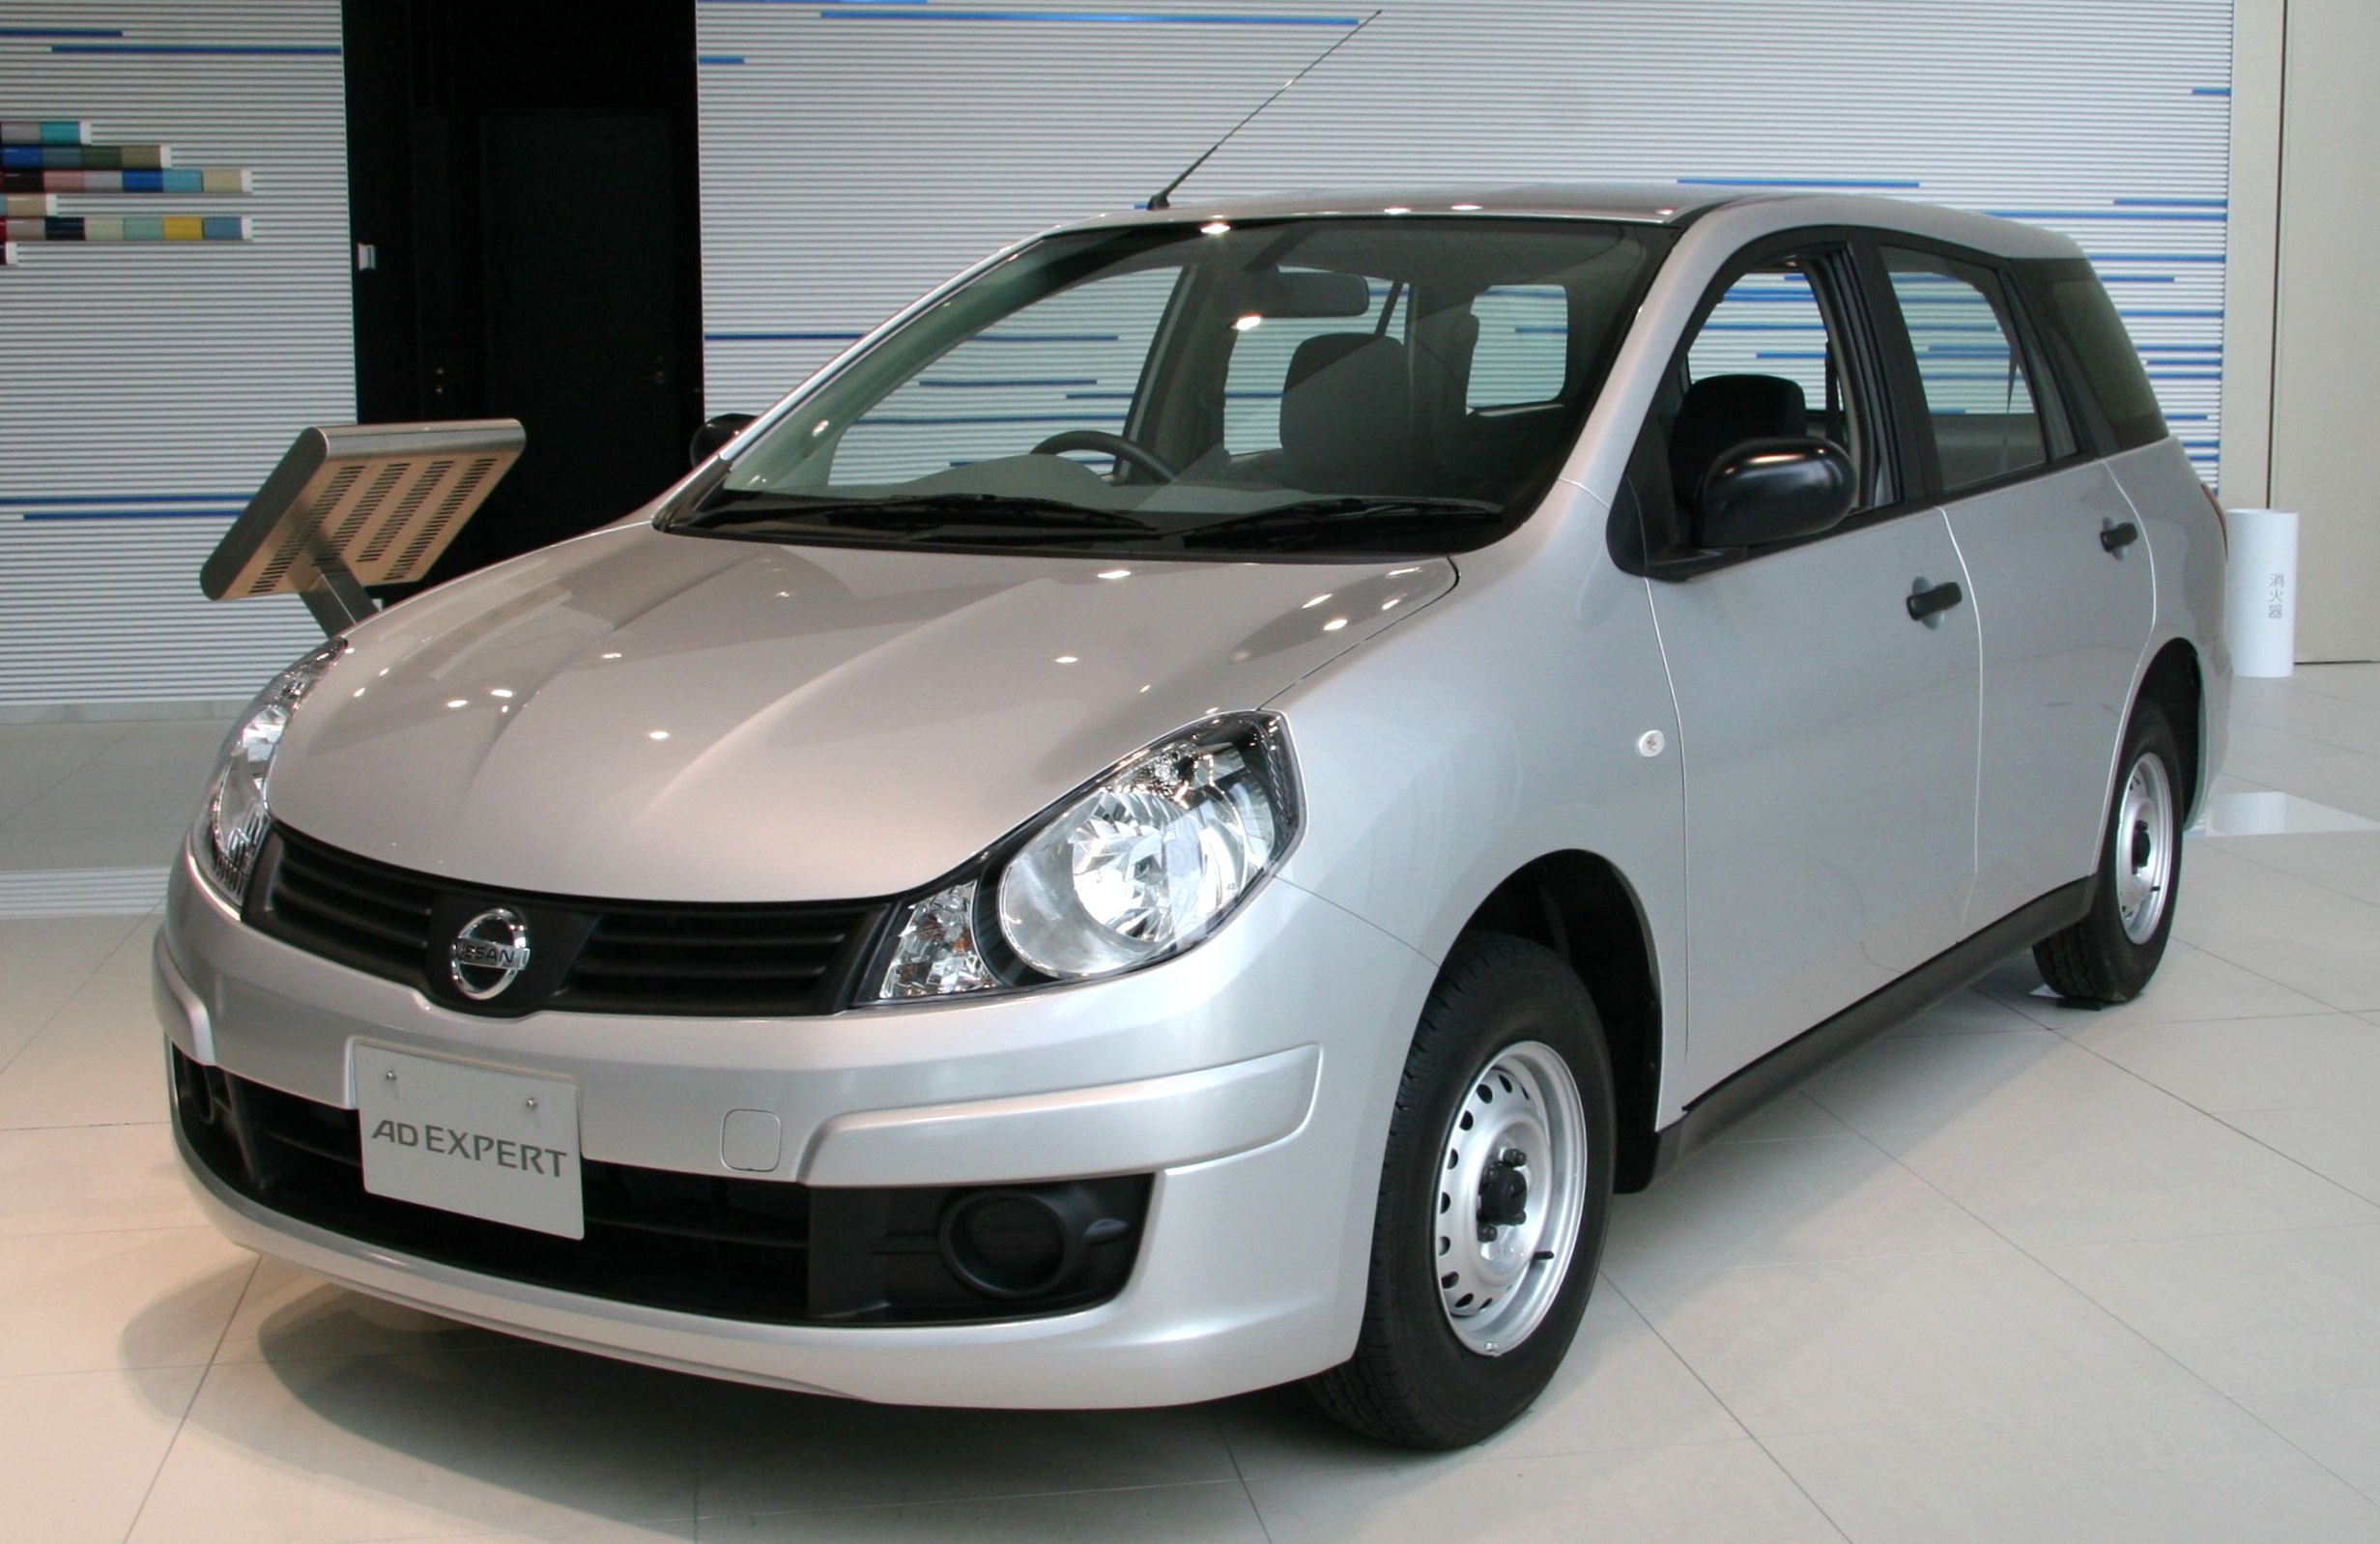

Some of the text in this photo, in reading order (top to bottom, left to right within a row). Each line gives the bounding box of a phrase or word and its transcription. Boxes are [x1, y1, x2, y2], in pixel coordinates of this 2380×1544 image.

[2268, 573, 2284, 619] 消火器
[372, 1120, 568, 1177] AD EXPERT
